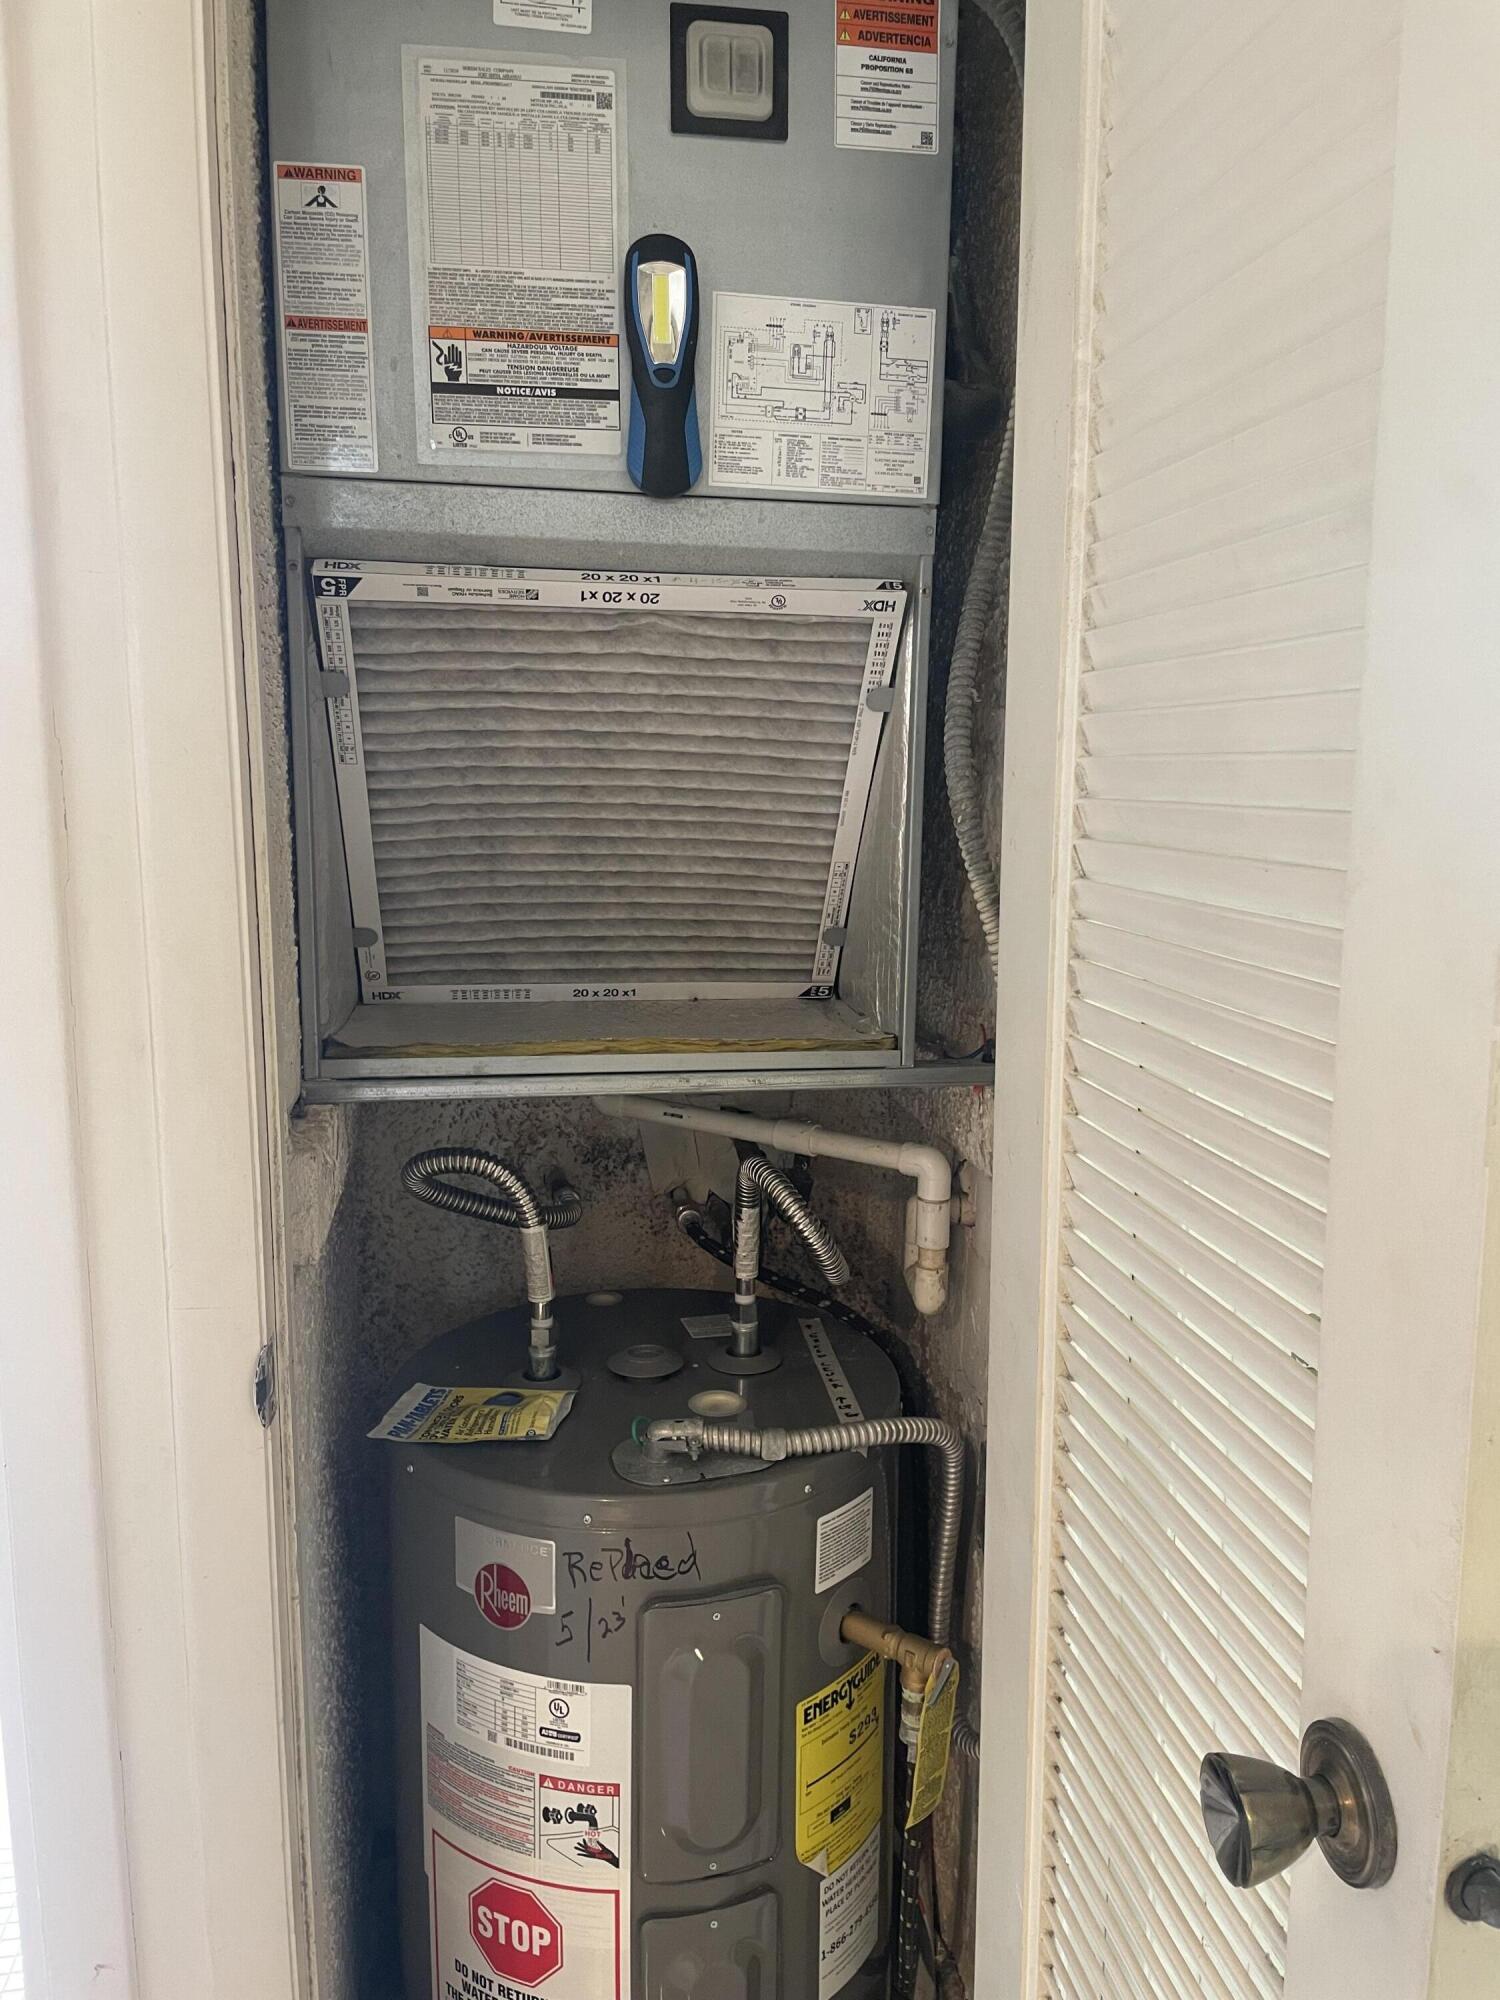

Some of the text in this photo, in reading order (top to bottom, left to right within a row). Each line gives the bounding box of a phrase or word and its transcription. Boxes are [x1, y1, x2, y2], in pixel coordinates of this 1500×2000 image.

[853, 9, 935, 27] AVERTISSEMENT
[858, 30, 931, 48] ADVERTENCIA
[868, 54, 907, 65] CALIFORNIA
[860, 63, 904, 74] PROPOSITION
[293, 167, 356, 180] WARNING
[298, 318, 367, 332] AVERTISSEMENT
[472, 329, 611, 345] WARNING/AVERTISSEMENT
[496, 385, 557, 397] NOTICE/AVIS
[324, 561, 361, 570] HDX
[581, 572, 600, 581] 20
[606, 574, 615, 582] x
[619, 574, 639, 582] 20
[643, 575, 660, 583] x1
[320, 577, 347, 596] FPR 5
[580, 590, 660, 604] 20 x 20 x1
[862, 600, 897, 613] HDX
[371, 991, 402, 1000] HDX
[572, 988, 637, 998] 20 x 20 x1
[817, 986, 830, 997] 5
[479, 1563, 529, 1617] Rheem
[508, 1765, 536, 1777] CAUTION
[557, 1782, 615, 1795] DANGER
[584, 1830, 602, 1838] HOT
[824, 1882, 834, 1895] DO
[835, 1869, 849, 1885] NOT
[822, 1885, 845, 1907] WATER
[825, 1897, 845, 1918] PLACE
[477, 1905, 551, 1956] STOP
[455, 1958, 469, 1978] DO
[472, 1969, 494, 1992] NOT
